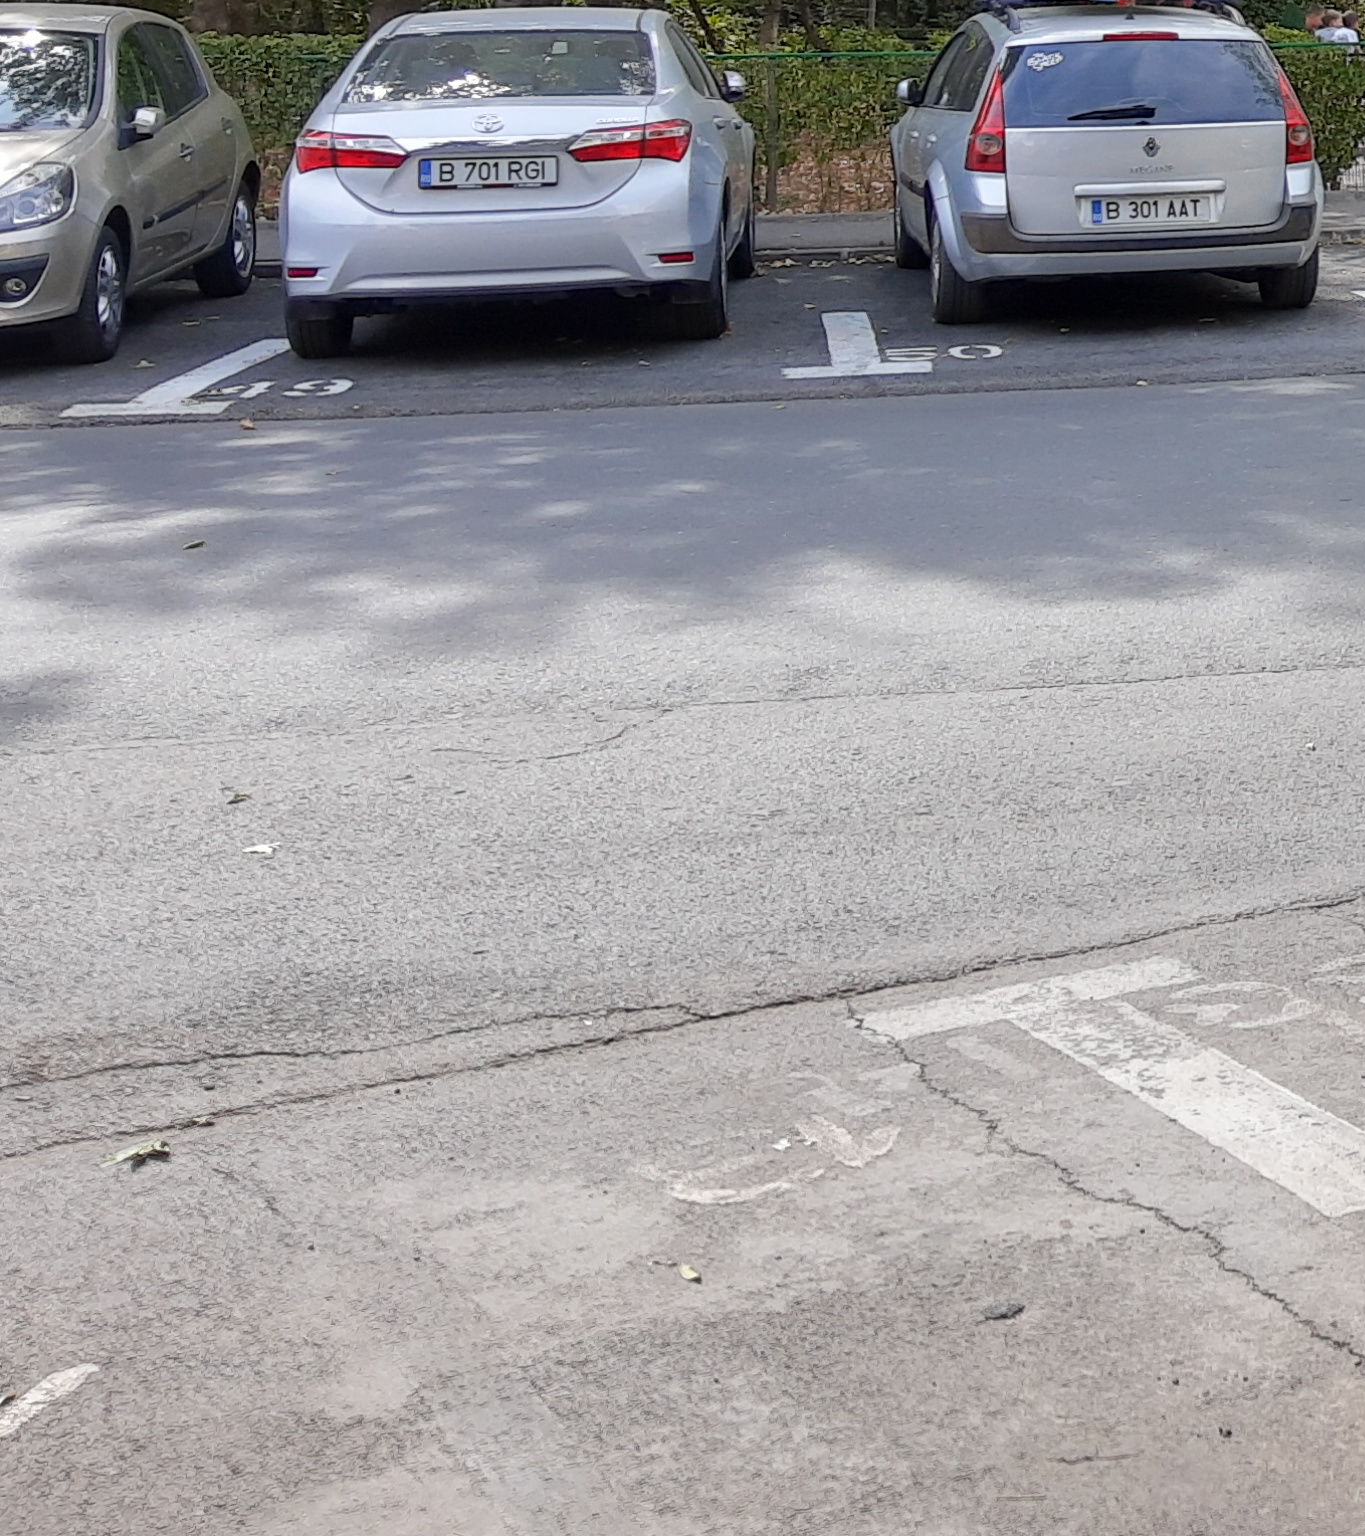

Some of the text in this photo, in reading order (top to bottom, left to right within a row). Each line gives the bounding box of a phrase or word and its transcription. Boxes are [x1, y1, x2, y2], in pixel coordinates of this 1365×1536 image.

[439, 161, 546, 182] B 701 RGI
[1106, 199, 1201, 220] B 301 AAT
[884, 345, 1004, 361] 50
[205, 379, 354, 398] 49
